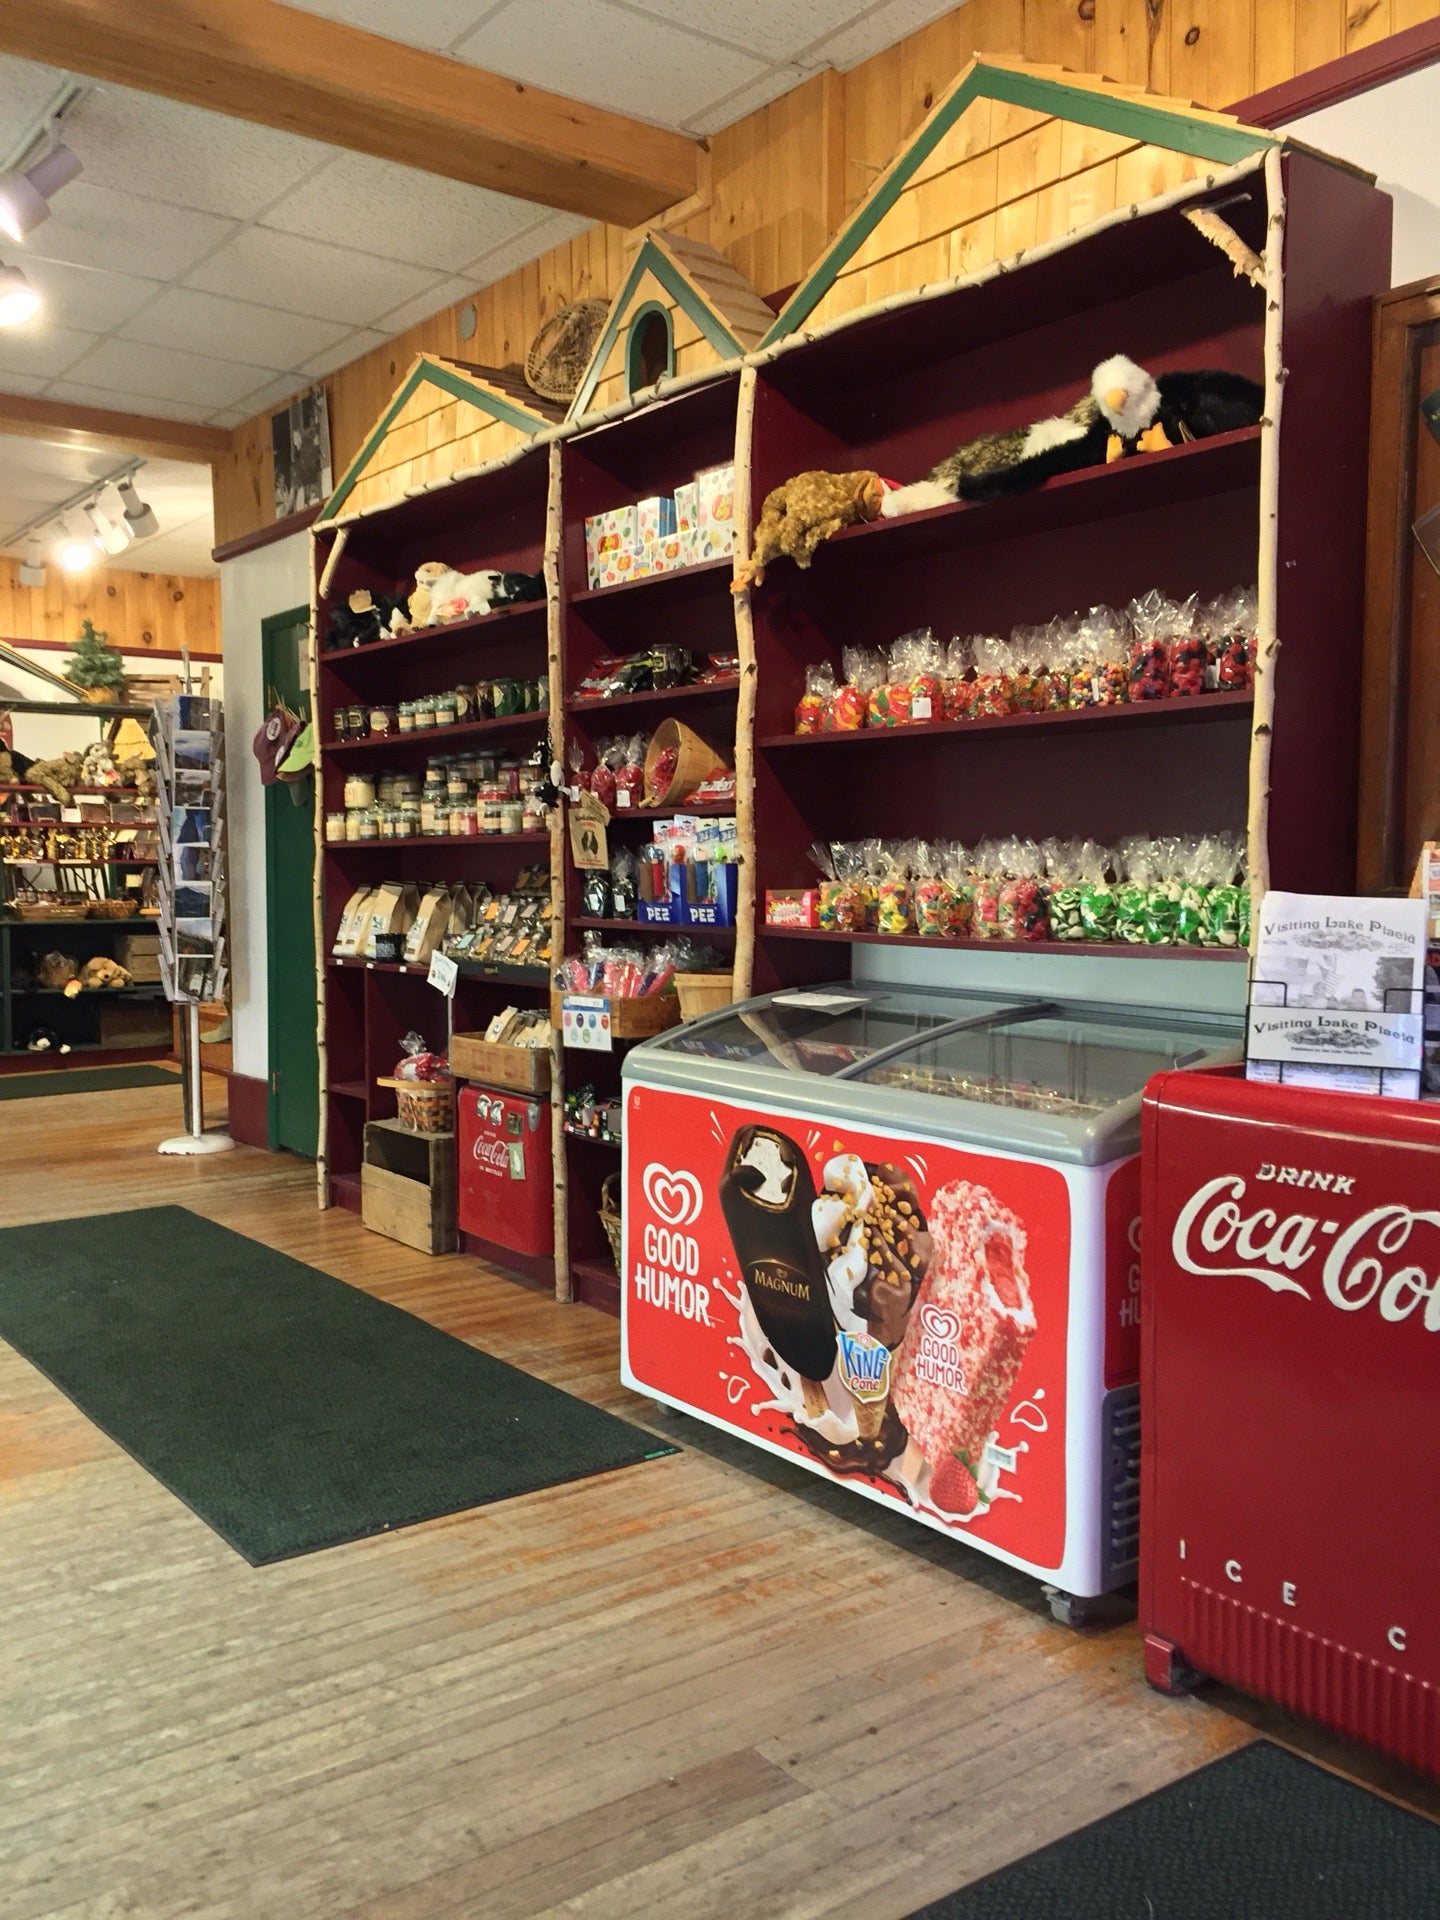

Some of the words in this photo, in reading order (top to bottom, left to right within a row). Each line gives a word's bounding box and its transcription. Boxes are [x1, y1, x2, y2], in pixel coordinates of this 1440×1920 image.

[646, 907, 670, 921] PEZ
[690, 908, 715, 922] PEZ
[1264, 921, 1320, 936] Visiting
[1325, 916, 1364, 931] Lake
[1254, 1020, 1312, 1034] Visiting
[1318, 1016, 1358, 1030] Lake
[1256, 1162, 1357, 1195] DRINK
[644, 1223, 699, 1276] GOOD
[635, 1262, 711, 1327] HUMOR
[754, 1268, 810, 1301] MAGNUM
[922, 1337, 957, 1366] GOOD
[850, 1377, 879, 1391] Cone
[916, 1356, 967, 1393] HUMOR
